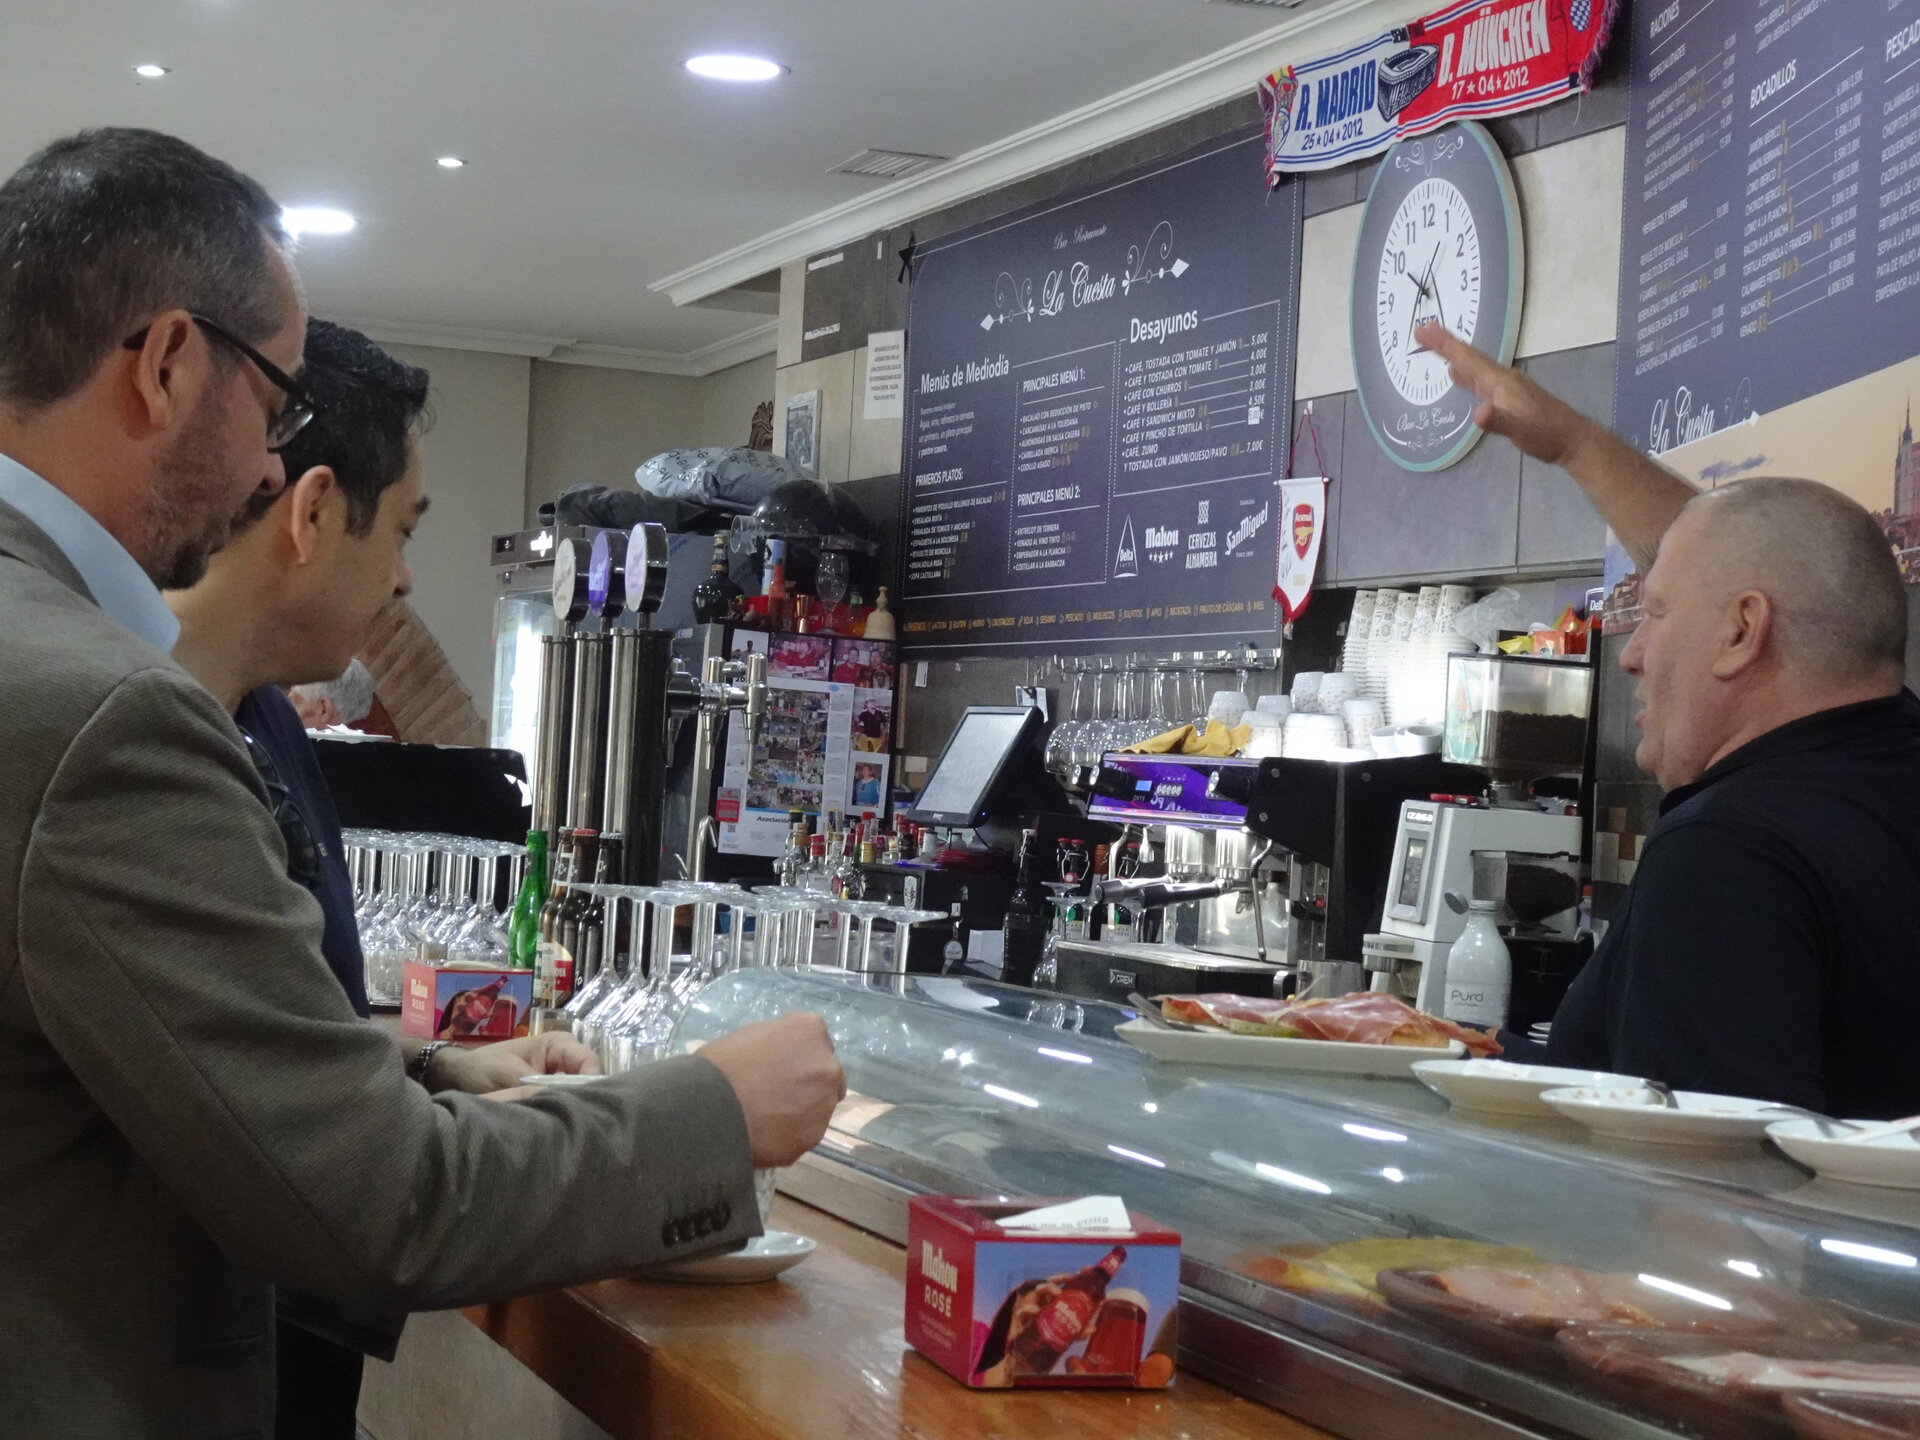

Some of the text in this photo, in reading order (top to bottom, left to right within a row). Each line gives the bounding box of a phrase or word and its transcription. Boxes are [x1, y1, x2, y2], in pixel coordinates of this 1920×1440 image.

[1438, 0, 1550, 88] B. MÜNCHEN
[1478, 76, 1495, 95] 04
[1502, 66, 1529, 91] 2012
[1750, 59, 1796, 109] BOCADILLOS
[1295, 59, 1377, 131] R. MADRID
[1323, 129, 1335, 147] 04
[1342, 118, 1364, 140] 2012
[1422, 203, 1435, 228] 12
[1444, 210, 1450, 233] 1
[1406, 221, 1416, 245] 11
[1456, 234, 1465, 258] 2
[1392, 253, 1406, 276] 10
[1039, 261, 1116, 316] La Cuesta
[1460, 270, 1468, 292] 3
[1388, 293, 1395, 314] 9
[1130, 310, 1198, 344] Desayunos
[1456, 314, 1463, 333] 4
[1145, 356, 1170, 370] TOSTADA
[1172, 353, 1184, 363] CON
[1186, 347, 1209, 360] TOMATE
[1215, 340, 1236, 353] JAMÓN
[1251, 332, 1268, 346] 5,00€
[1392, 331, 1398, 348] 8
[921, 370, 949, 395] Menús
[952, 365, 963, 387] de
[965, 353, 1009, 384] Mediodía
[1128, 374, 1142, 387] CAFÉ
[1148, 369, 1173, 383] TOSTADA
[1174, 366, 1187, 378] CON
[1188, 361, 1211, 375] TOMATE
[1405, 360, 1411, 373] 7
[1424, 367, 1430, 381] 6
[1022, 373, 1059, 393] PRINCIPALES
[1060, 366, 1079, 385] MENÚ
[1127, 388, 1141, 402] CAFÉ
[1142, 388, 1154, 399] CON
[1156, 382, 1182, 396] CHURROS
[1127, 403, 1140, 415] CAFÉ
[1146, 397, 1172, 412] BOLLERÍA
[1126, 417, 1140, 430] CAFÉ
[1146, 412, 1176, 426] SANDWICH
[1177, 409, 1195, 421] MIXTO
[1125, 431, 1139, 444] CAFÉ
[1145, 428, 1167, 441] PINCHO
[1168, 427, 1176, 436] DE
[1177, 422, 1202, 435] TORTILLA
[1141, 444, 1158, 456] ZUMO
[1128, 459, 1153, 472] TOSTADA
[1154, 457, 1166, 467] CON
[915, 471, 942, 487] PRIMEROS
[1017, 489, 1054, 507] PRINCIPALES
[1055, 483, 1074, 501] MENÚ
[1145, 525, 1179, 549] Mahou
[1188, 531, 1217, 550] CERVEZAS
[1119, 548, 1133, 562] Delta
[1185, 551, 1218, 569] ALHAMBRA
[922, 1239, 958, 1294] Mahou
